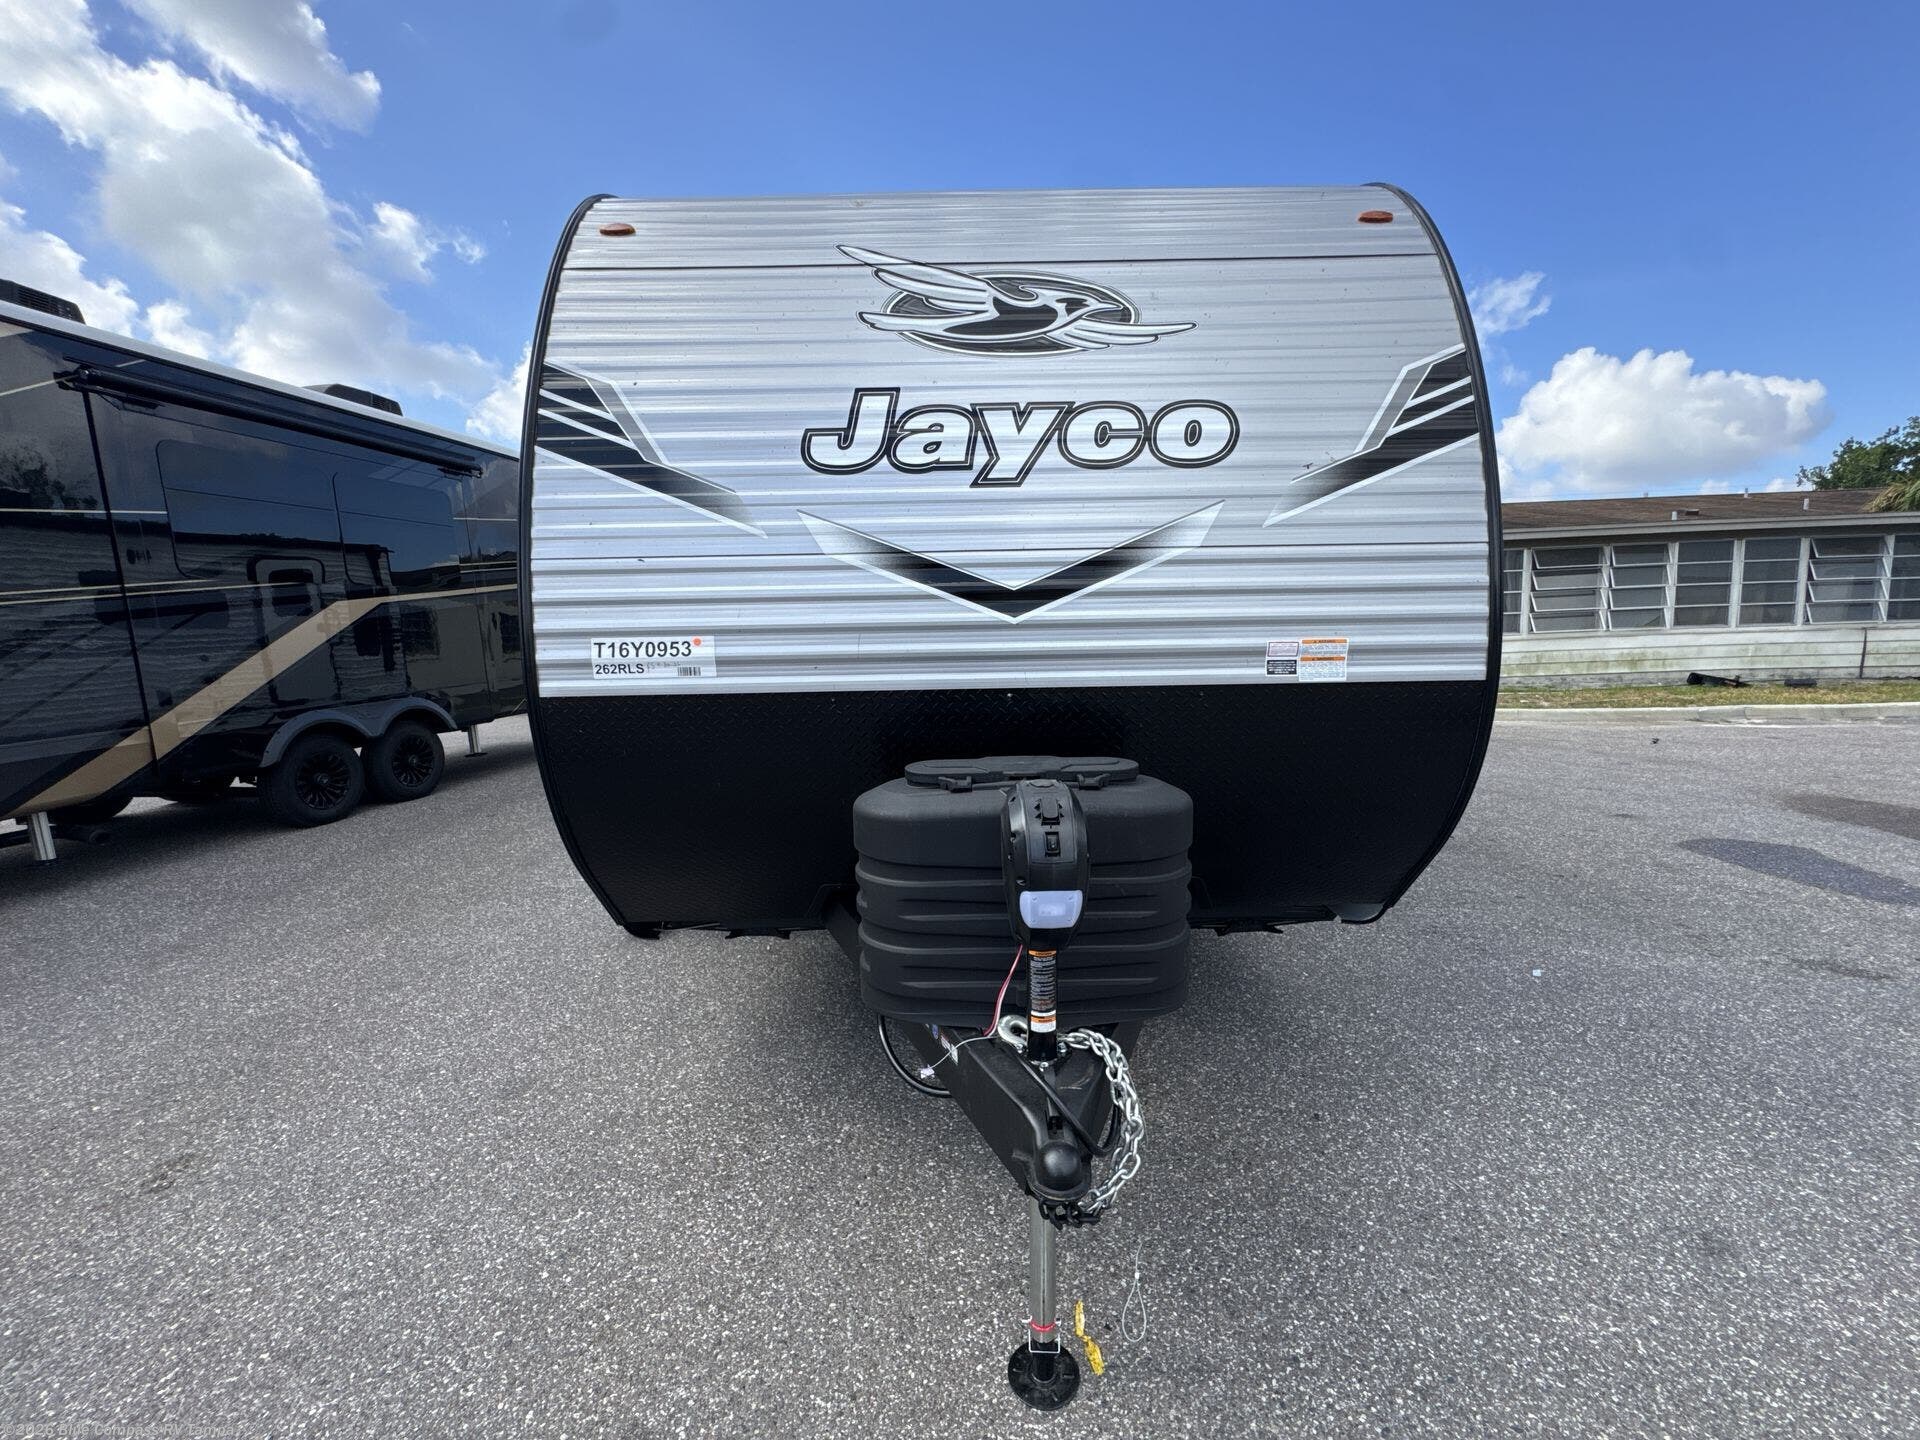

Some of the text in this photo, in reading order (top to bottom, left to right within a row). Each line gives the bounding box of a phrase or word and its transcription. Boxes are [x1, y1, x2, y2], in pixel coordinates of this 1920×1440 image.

[800, 387, 1240, 488] Jayco
[593, 640, 692, 659] T16Y0953
[594, 663, 645, 675] 262RLS
